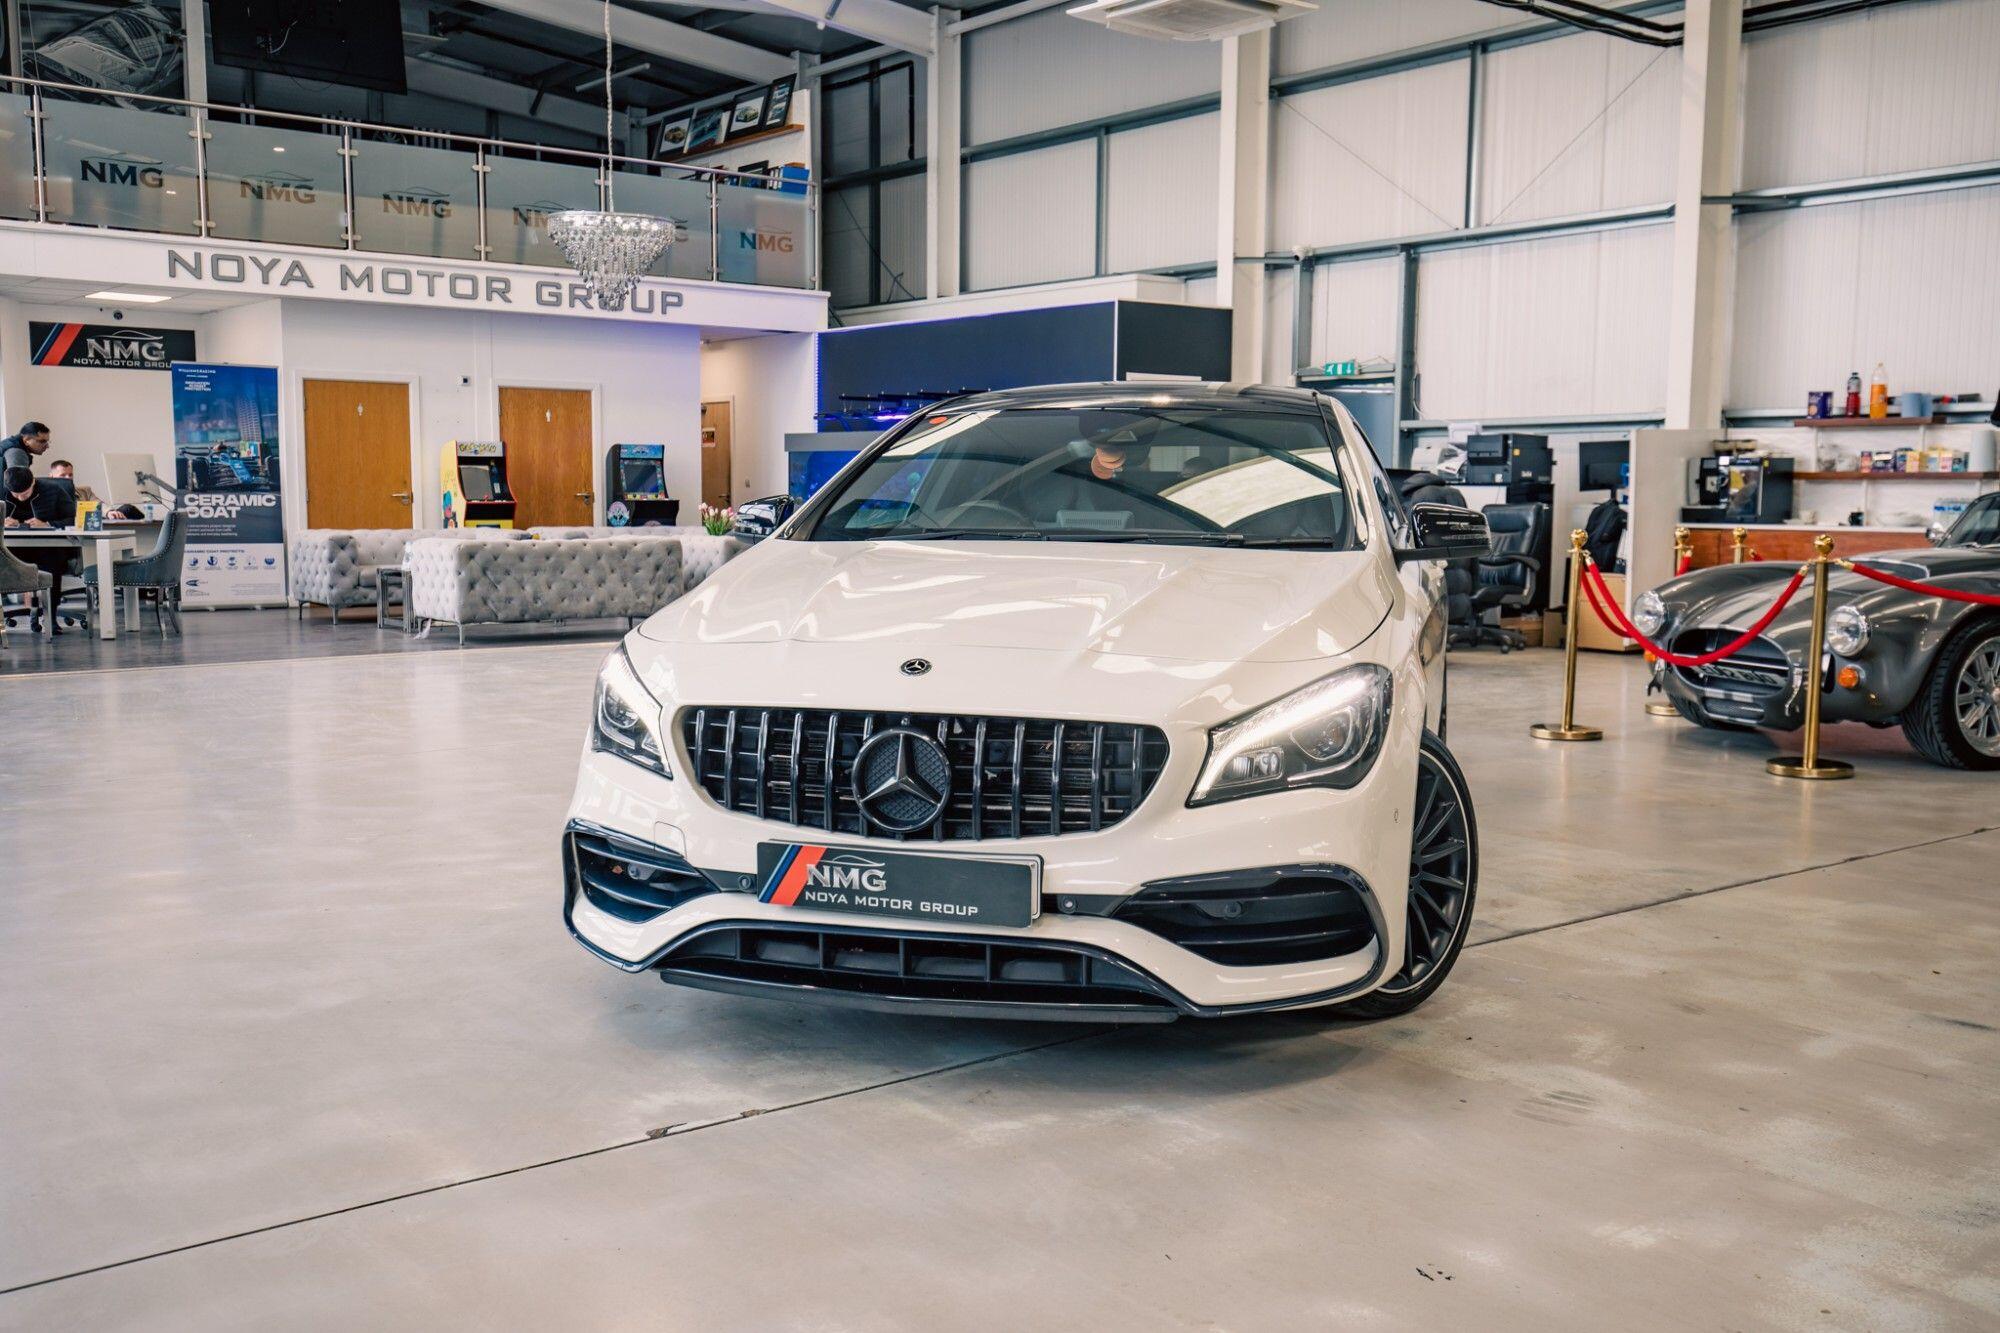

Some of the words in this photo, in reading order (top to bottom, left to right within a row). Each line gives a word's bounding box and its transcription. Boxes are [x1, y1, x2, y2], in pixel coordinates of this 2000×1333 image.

[80, 160, 164, 189] NMG
[240, 180, 316, 204] NMG
[382, 194, 453, 218] NMG
[740, 231, 793, 252] NMG
[168, 250, 314, 288] NOYA
[340, 264, 513, 303] MOTOR
[87, 338, 165, 360] NMG
[105, 360, 141, 368] MOTOR
[184, 494, 276, 507] CERAMIC
[187, 506, 241, 519] COAT
[806, 864, 887, 892] NMG
[805, 891, 848, 904] NOYA
[855, 896, 912, 911] MOTOR
[920, 901, 978, 916] GROUP
